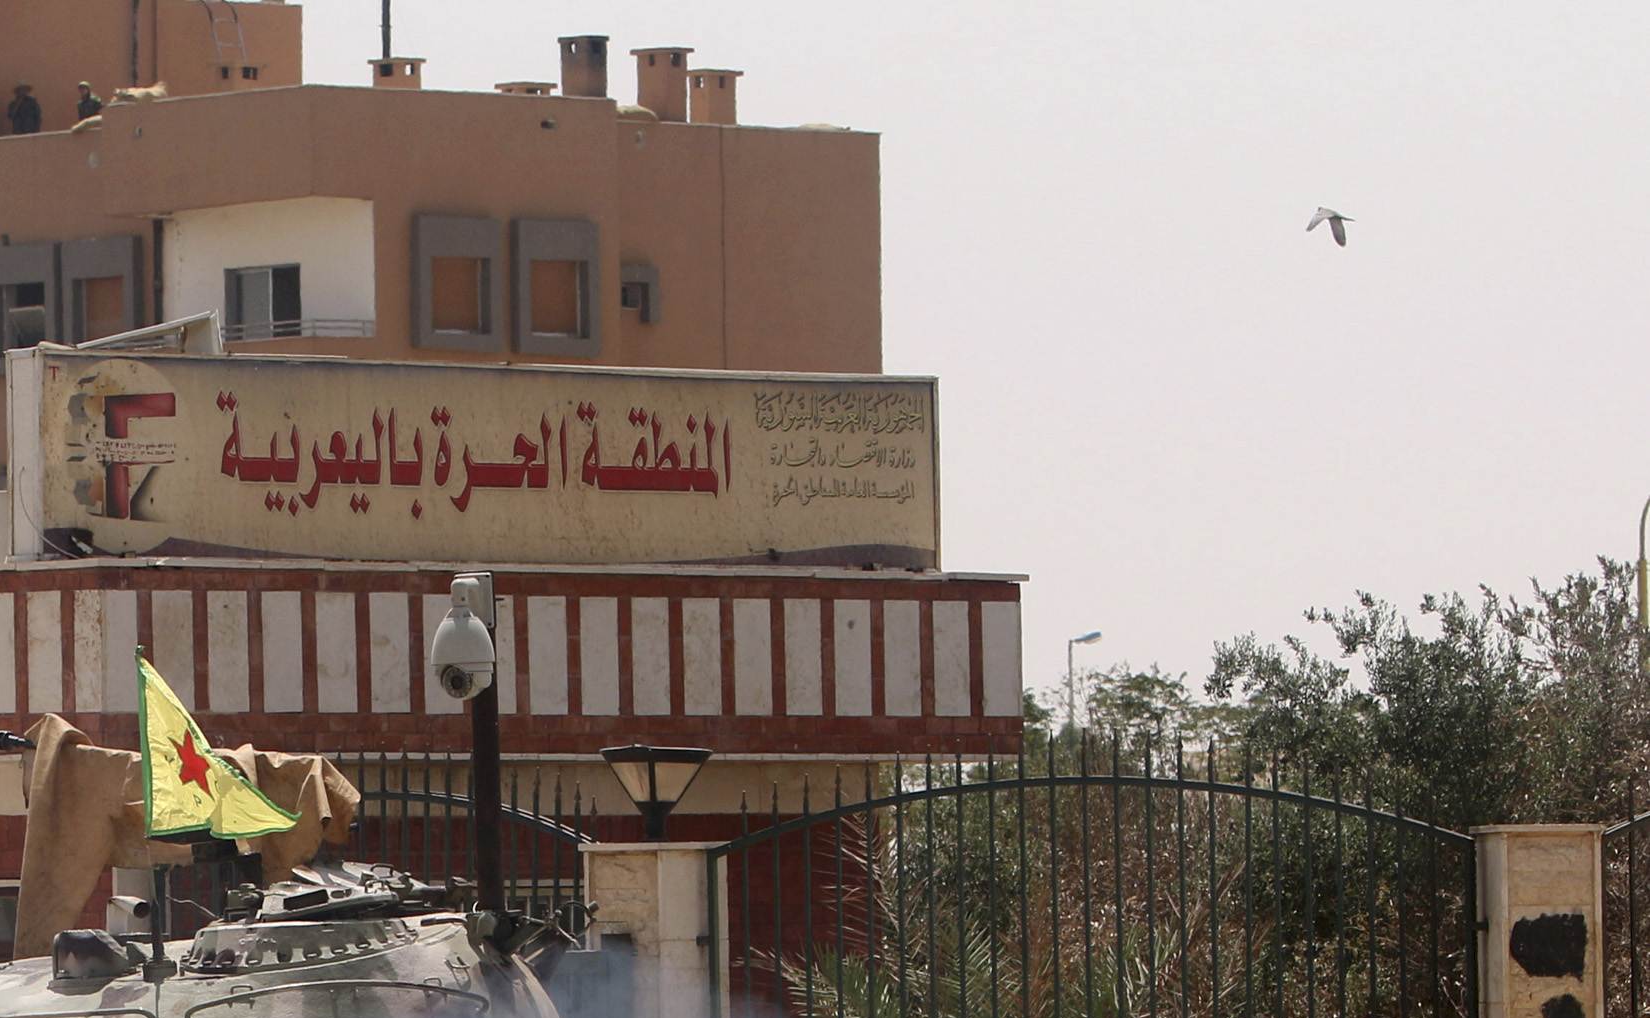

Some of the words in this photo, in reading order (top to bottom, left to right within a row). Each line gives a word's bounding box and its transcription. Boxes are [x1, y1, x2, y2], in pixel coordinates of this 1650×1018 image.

[216, 390, 424, 521] باليعربية
[430, 405, 568, 513] الحرة
[576, 400, 733, 499] المنطقة
